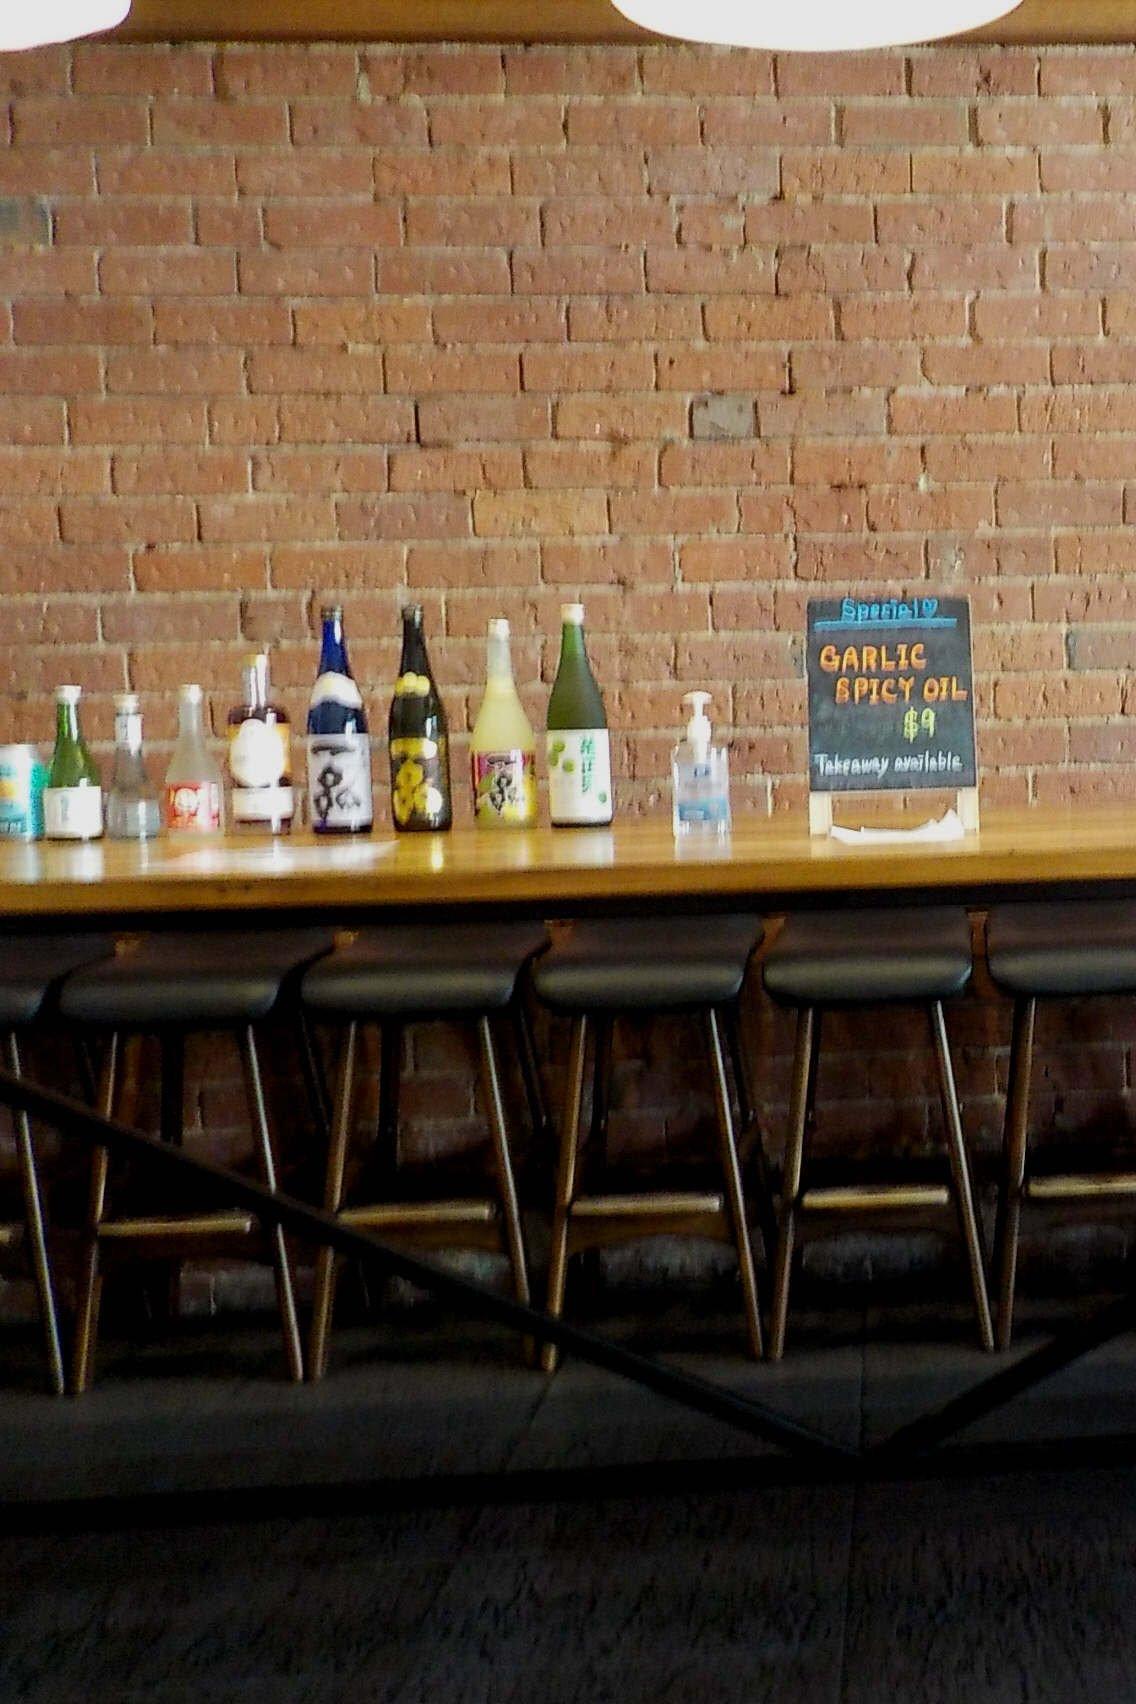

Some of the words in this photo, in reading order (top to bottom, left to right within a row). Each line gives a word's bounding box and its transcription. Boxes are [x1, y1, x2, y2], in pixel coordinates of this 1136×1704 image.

[841, 597, 918, 623] Special
[820, 643, 927, 673] GARLIC
[836, 676, 915, 705] SPICY
[923, 675, 968, 701] OIL
[903, 706, 936, 743] $9
[814, 752, 889, 780] Takeaway
[895, 749, 963, 773] available
